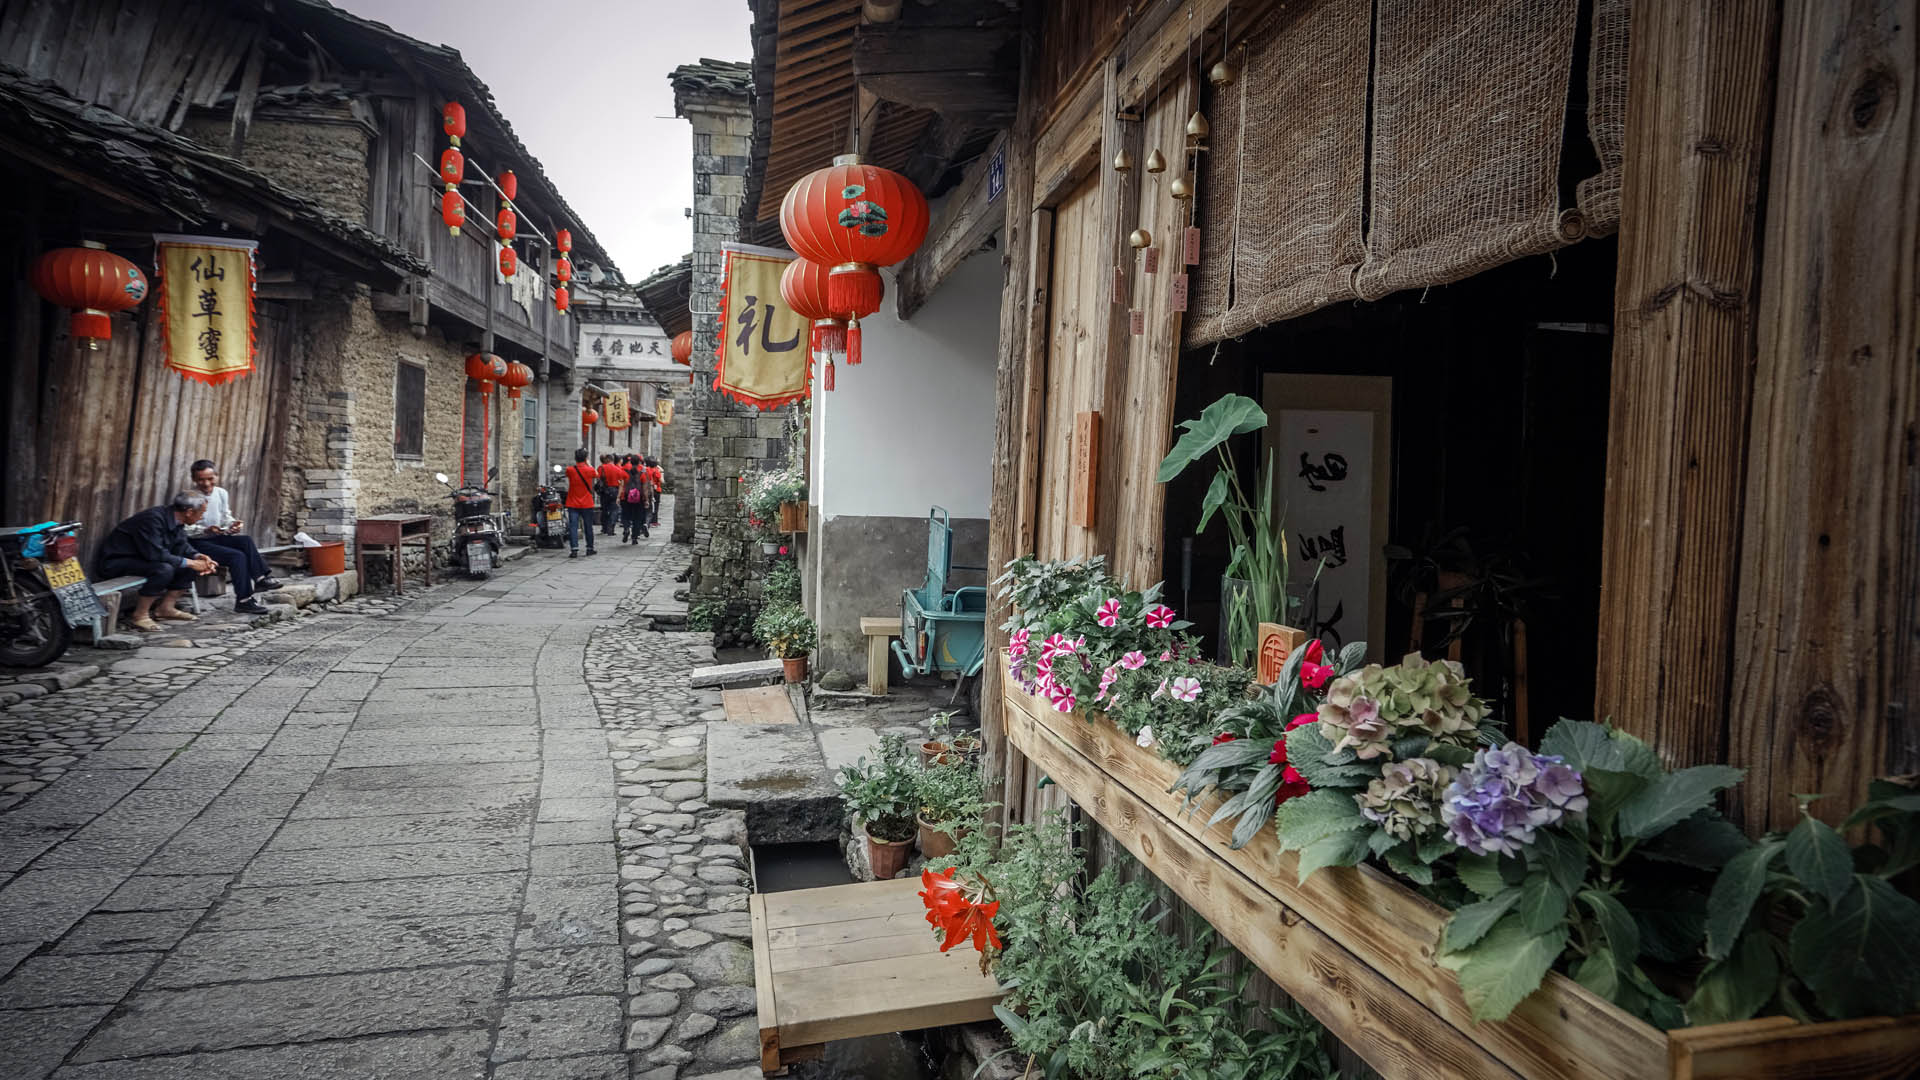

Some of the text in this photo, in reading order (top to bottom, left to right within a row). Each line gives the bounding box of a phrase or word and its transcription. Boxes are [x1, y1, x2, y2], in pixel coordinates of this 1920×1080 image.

[190, 254, 225, 361] 仙草蜜
[736, 295, 800, 356] 礼
[608, 394, 626, 423] 古玩
